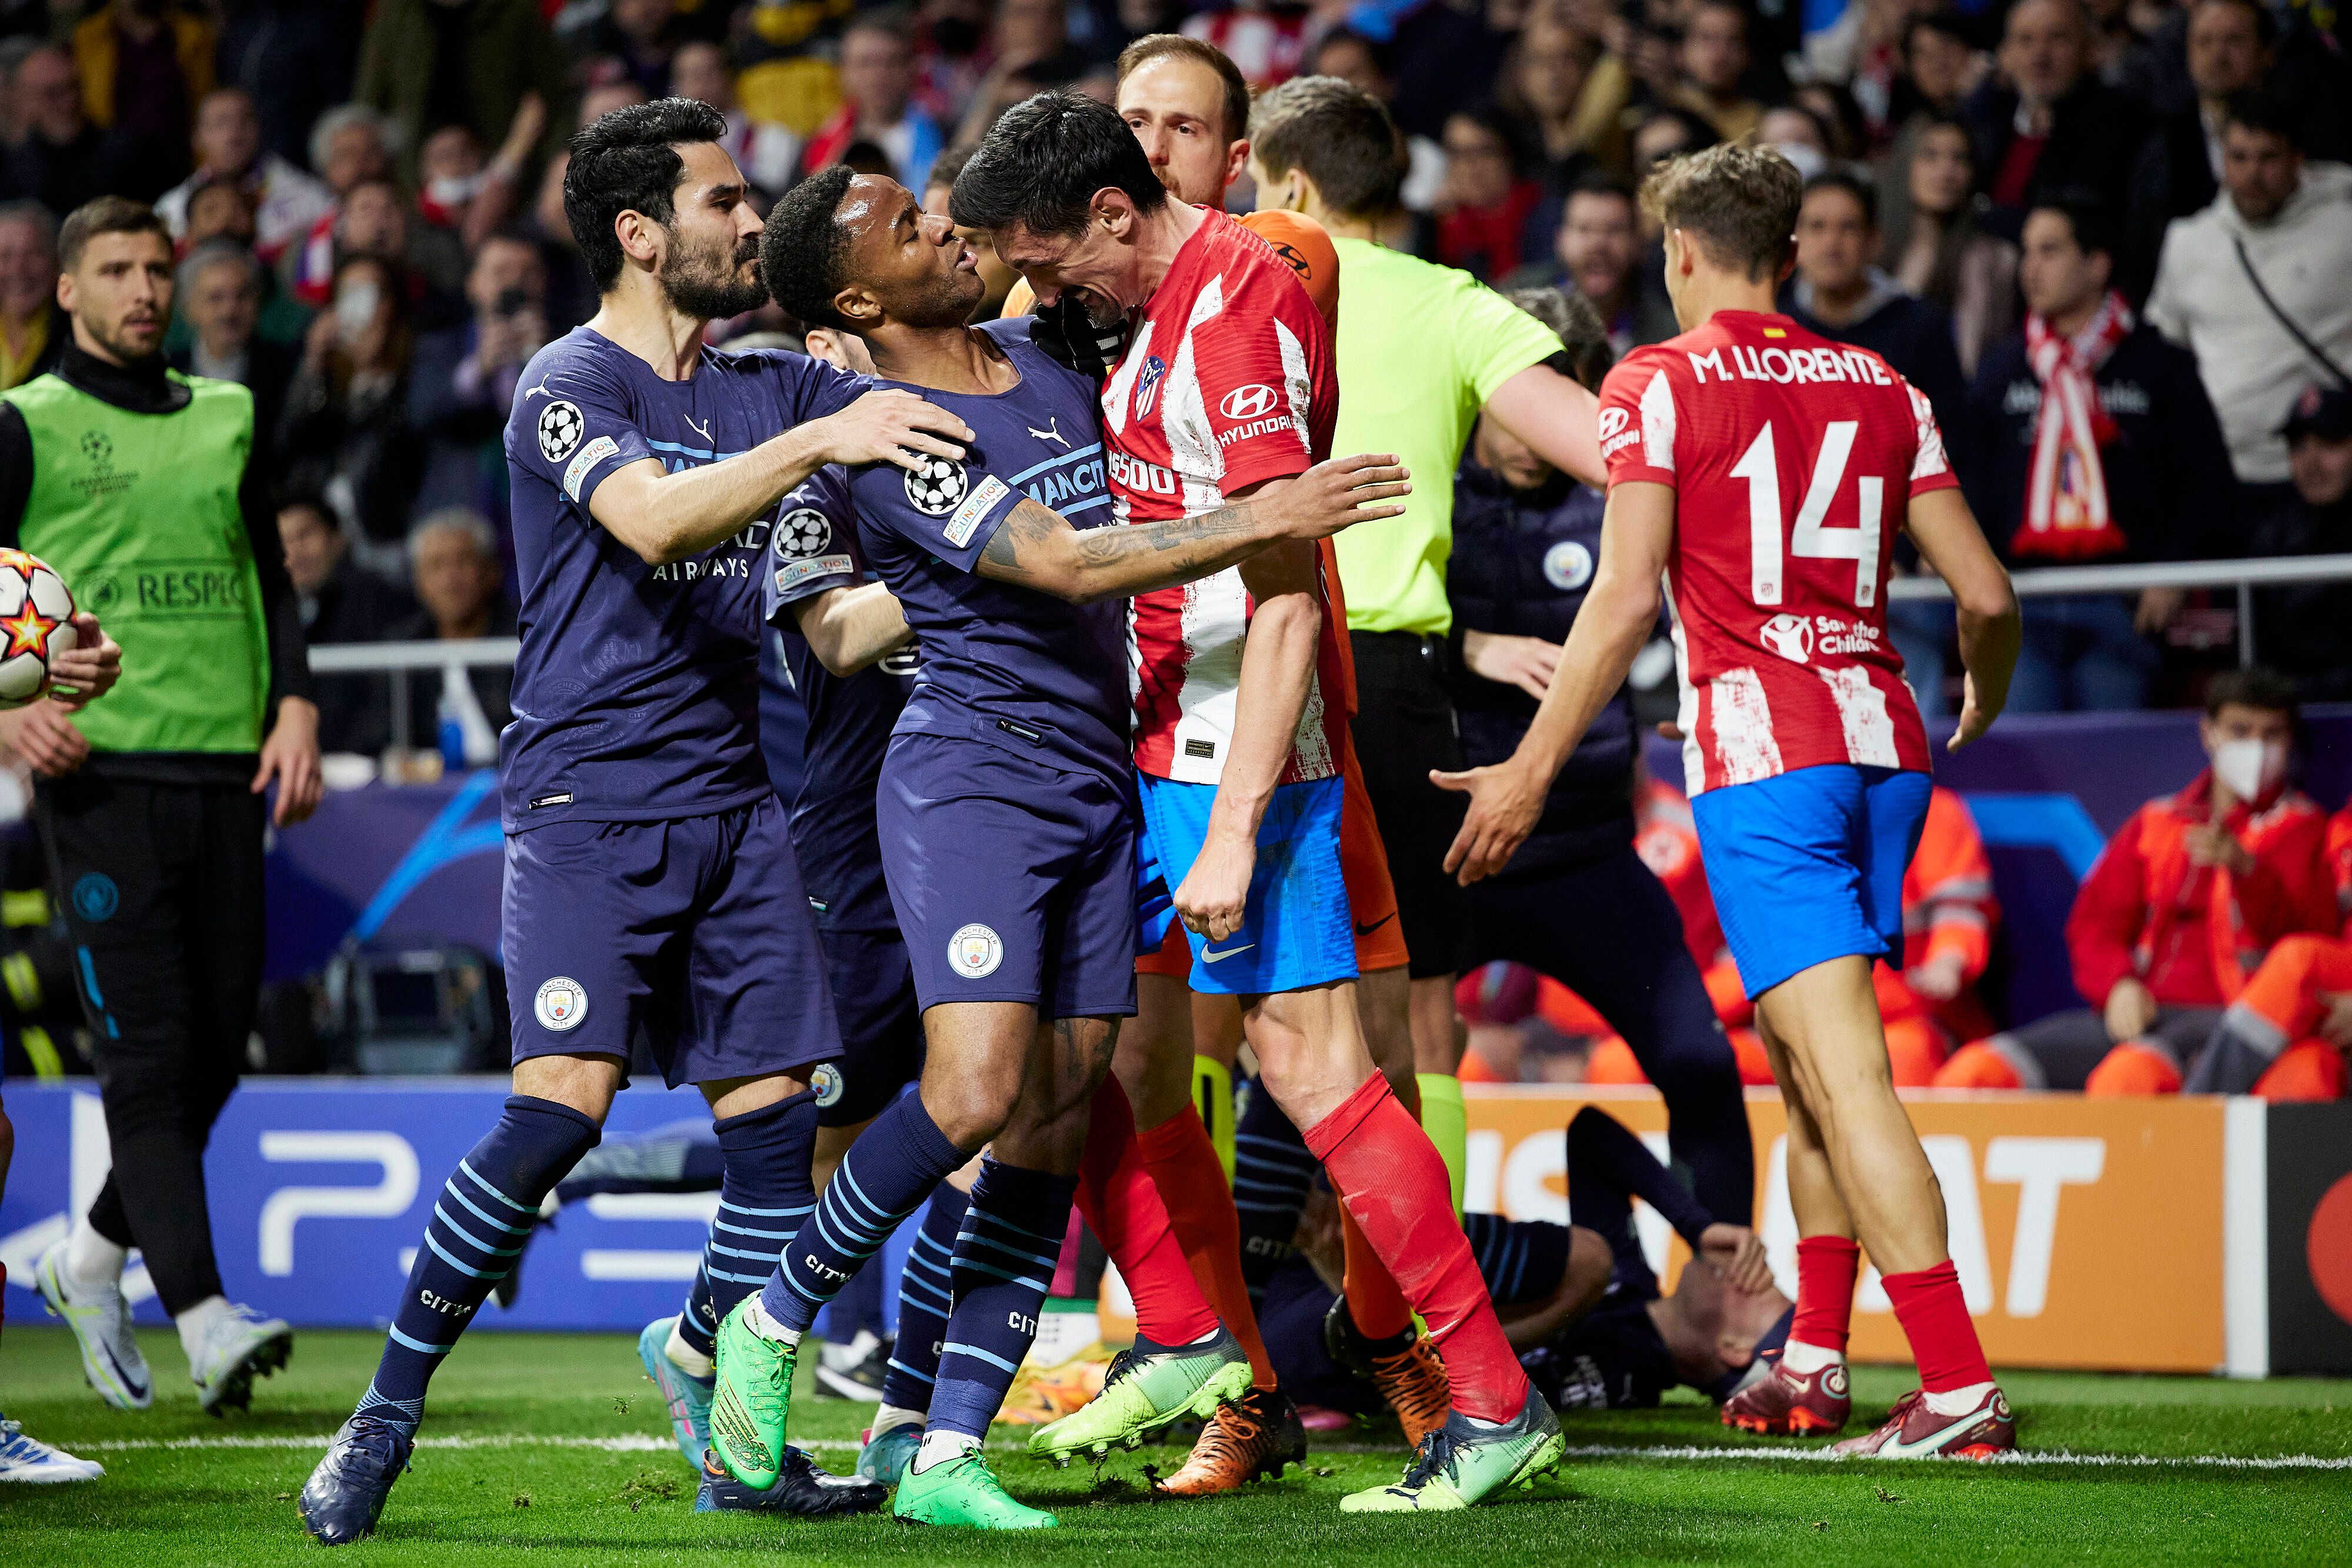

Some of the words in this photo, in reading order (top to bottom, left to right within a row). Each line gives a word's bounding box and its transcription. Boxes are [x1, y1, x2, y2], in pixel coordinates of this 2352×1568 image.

[1687, 347, 1734, 384] M.
[1730, 345, 1892, 386] LLORENTE
[1217, 415, 1293, 447] HYUNDAI
[951, 480, 1003, 541] FOUNDATION
[1729, 419, 1884, 607] 14
[954, 927, 998, 945] MANCHESTER
[539, 980, 582, 998] MANCHESTER
